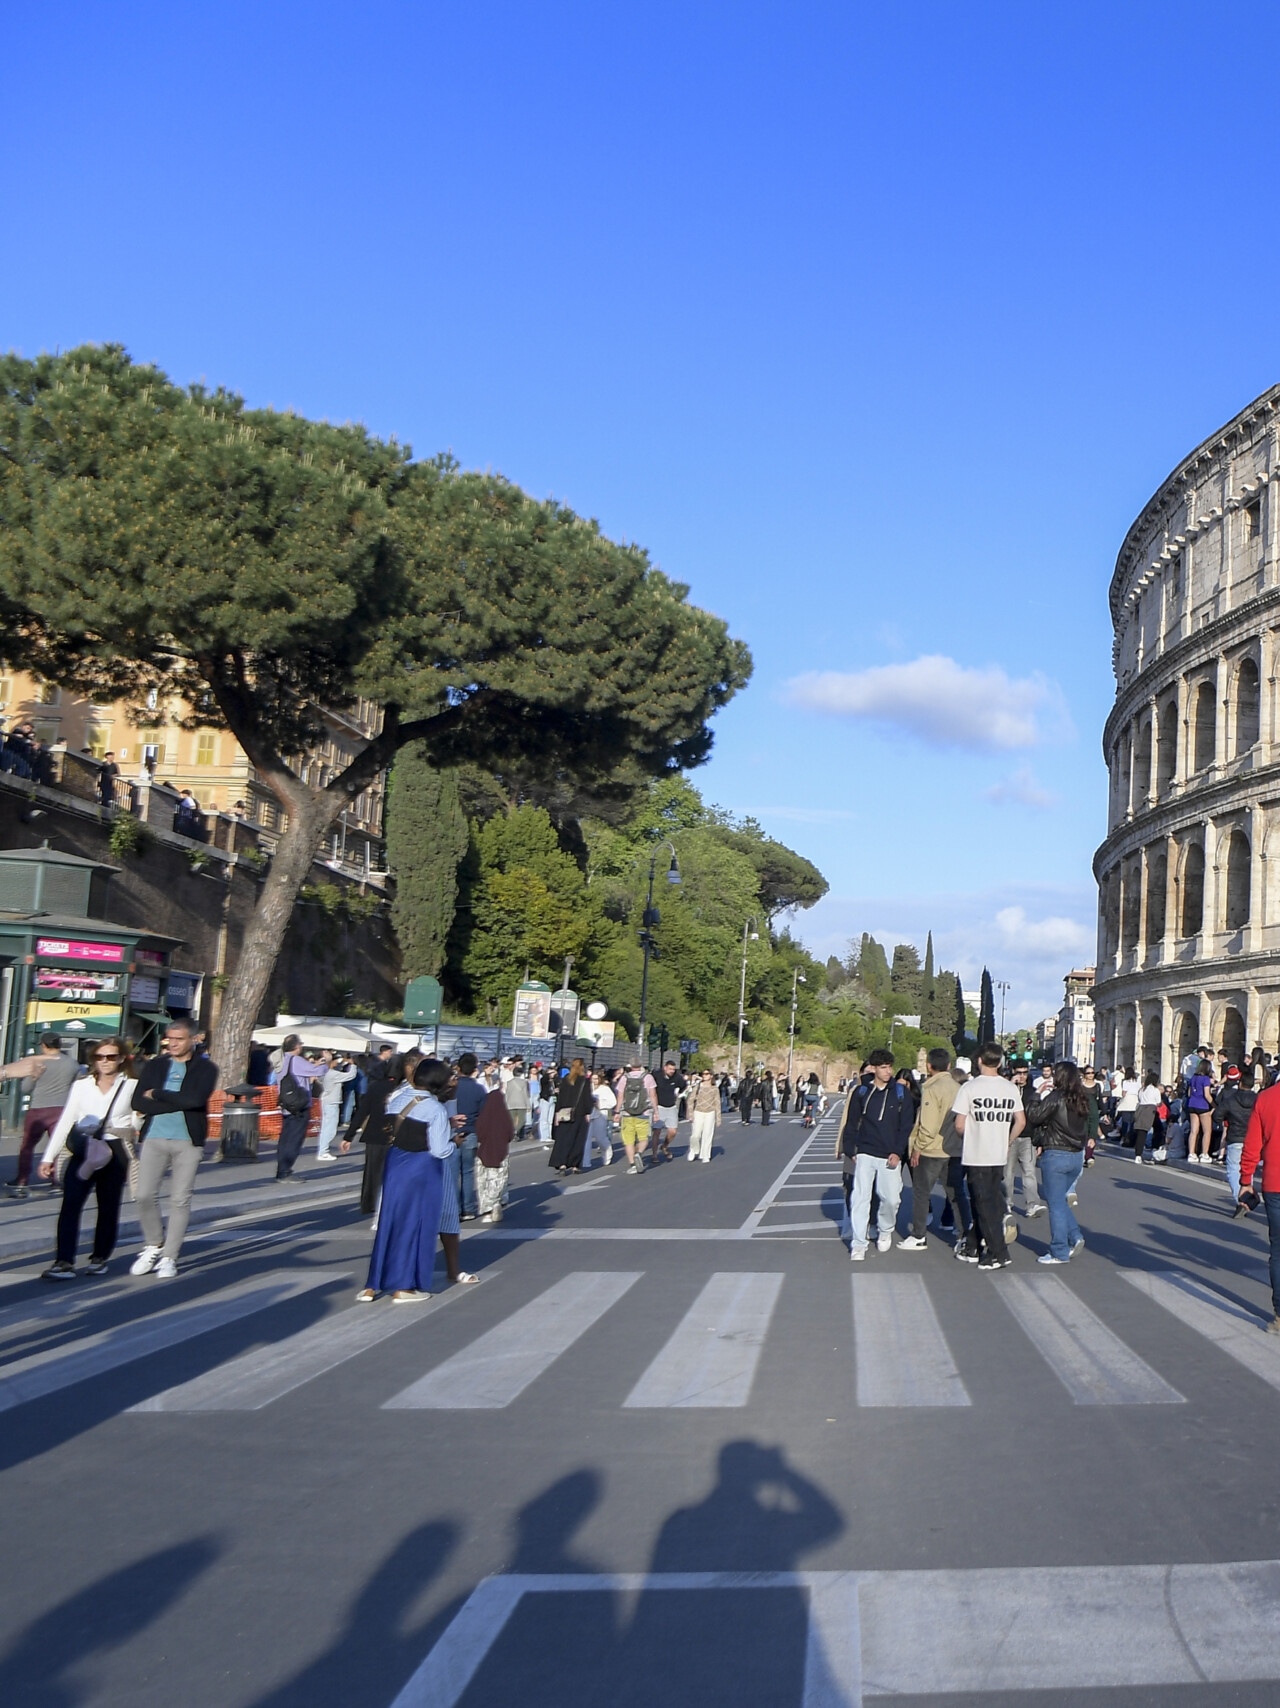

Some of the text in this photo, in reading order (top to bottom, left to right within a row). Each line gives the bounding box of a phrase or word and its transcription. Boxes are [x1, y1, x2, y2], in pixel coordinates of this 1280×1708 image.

[61, 988, 97, 999] ATM
[65, 1006, 91, 1015] ATM
[972, 1098, 1015, 1109] SOLID
